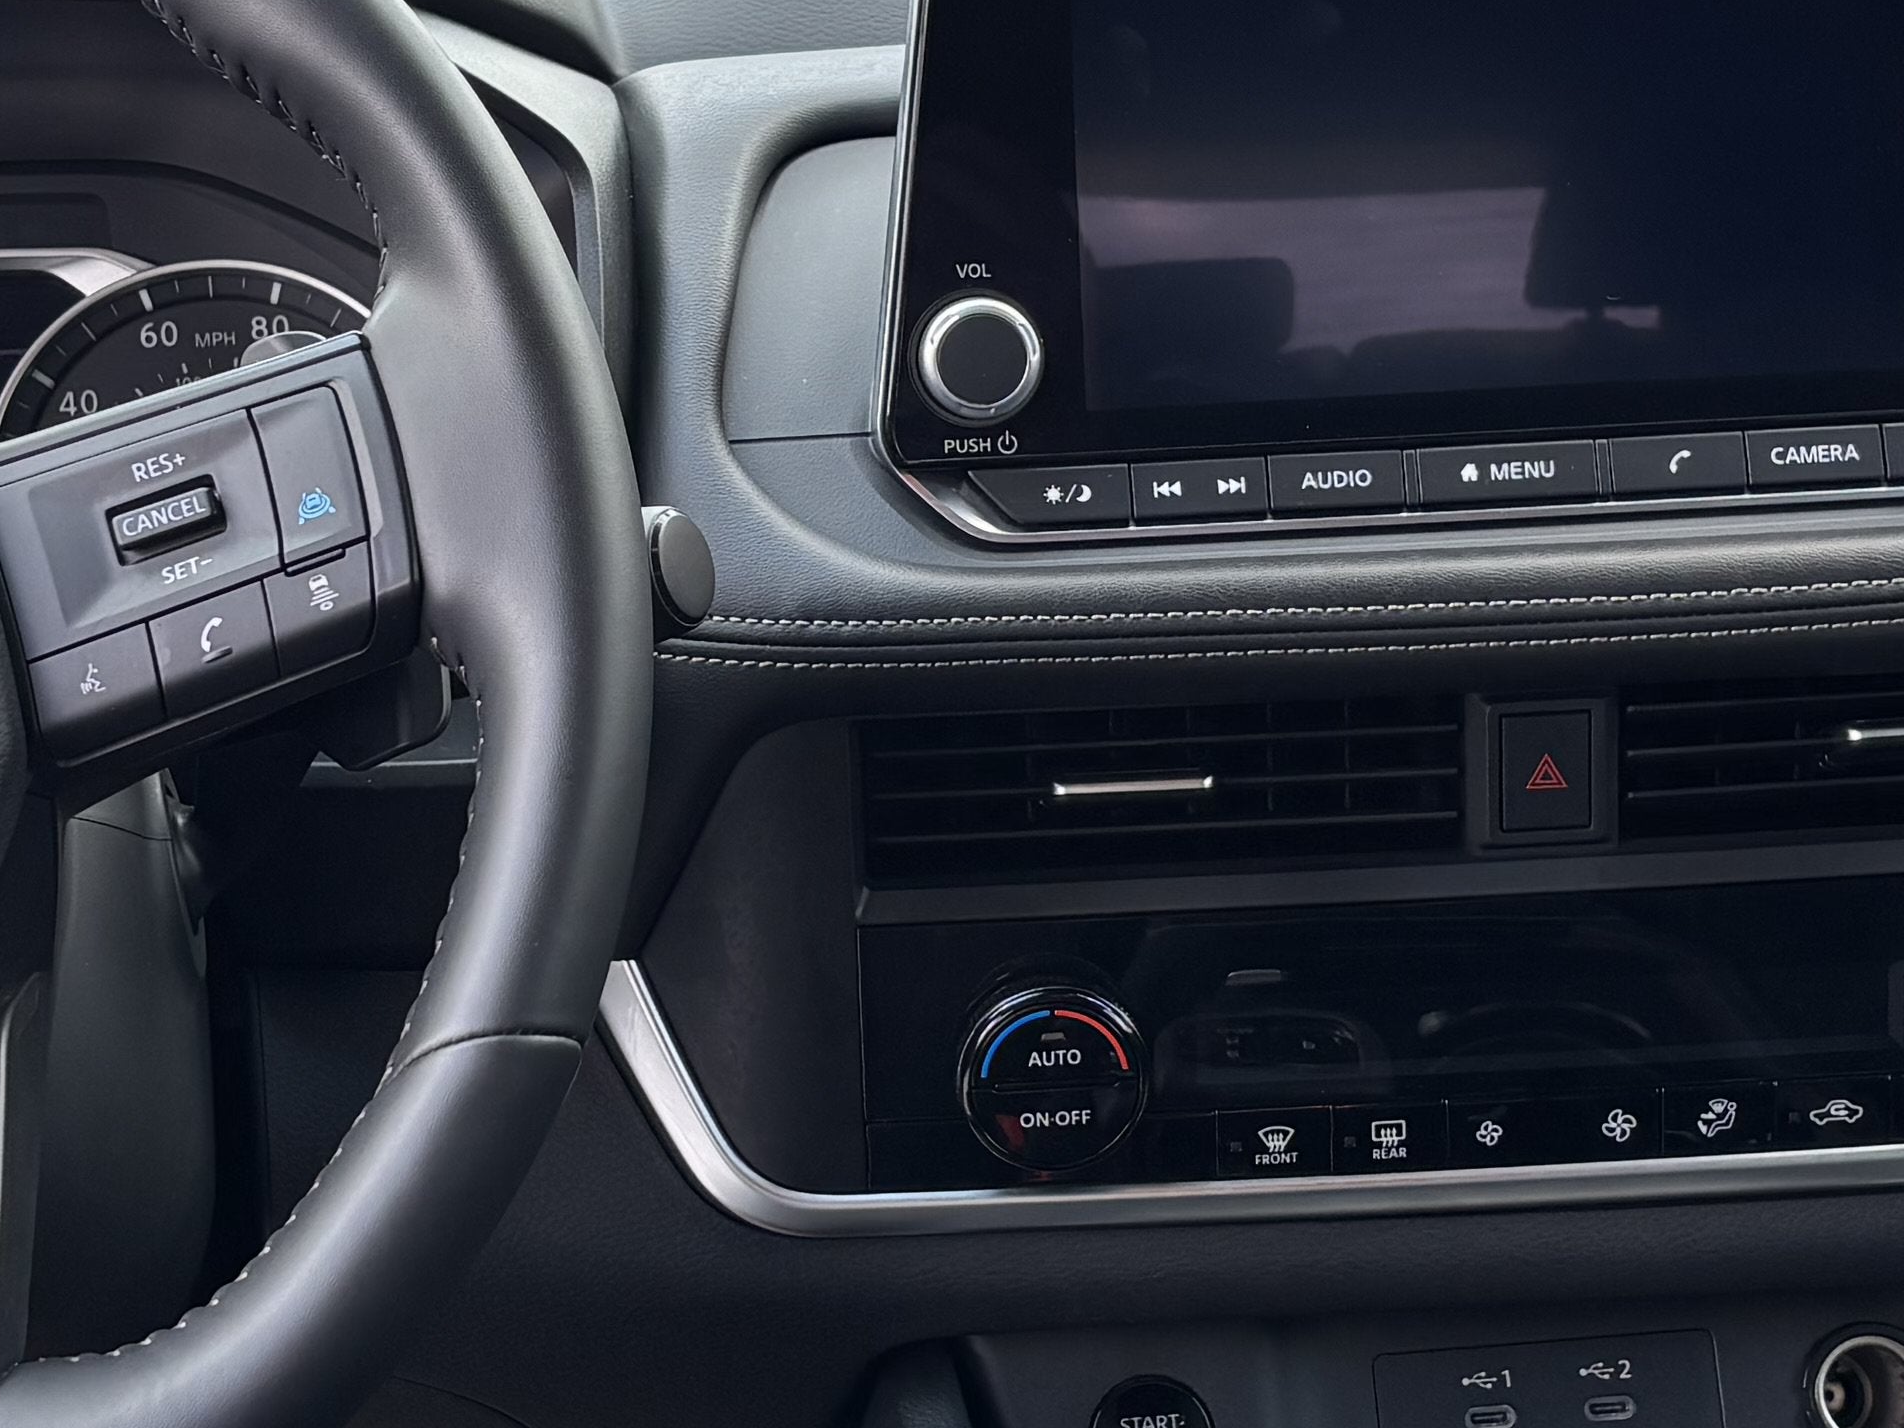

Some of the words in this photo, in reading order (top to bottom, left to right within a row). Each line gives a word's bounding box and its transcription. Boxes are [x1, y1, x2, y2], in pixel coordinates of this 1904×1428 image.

[955, 263, 992, 279] VOL
[139, 320, 179, 349] 60
[250, 314, 290, 341] 80
[194, 330, 237, 349] MPH
[58, 388, 99, 417] 40
[943, 437, 992, 454] PUSH
[1770, 443, 1861, 467] CAMERA
[131, 451, 187, 483] RES+
[1490, 459, 1556, 481] MENU
[1301, 468, 1373, 490] AUDIO
[122, 495, 207, 537] CANCEL
[1027, 1048, 1082, 1069] AUTO
[1255, 1151, 1299, 1166] FRONT
[1372, 1146, 1407, 1160] REAR
[1501, 1369, 1512, 1388] 1
[1618, 1359, 1632, 1379] 2
